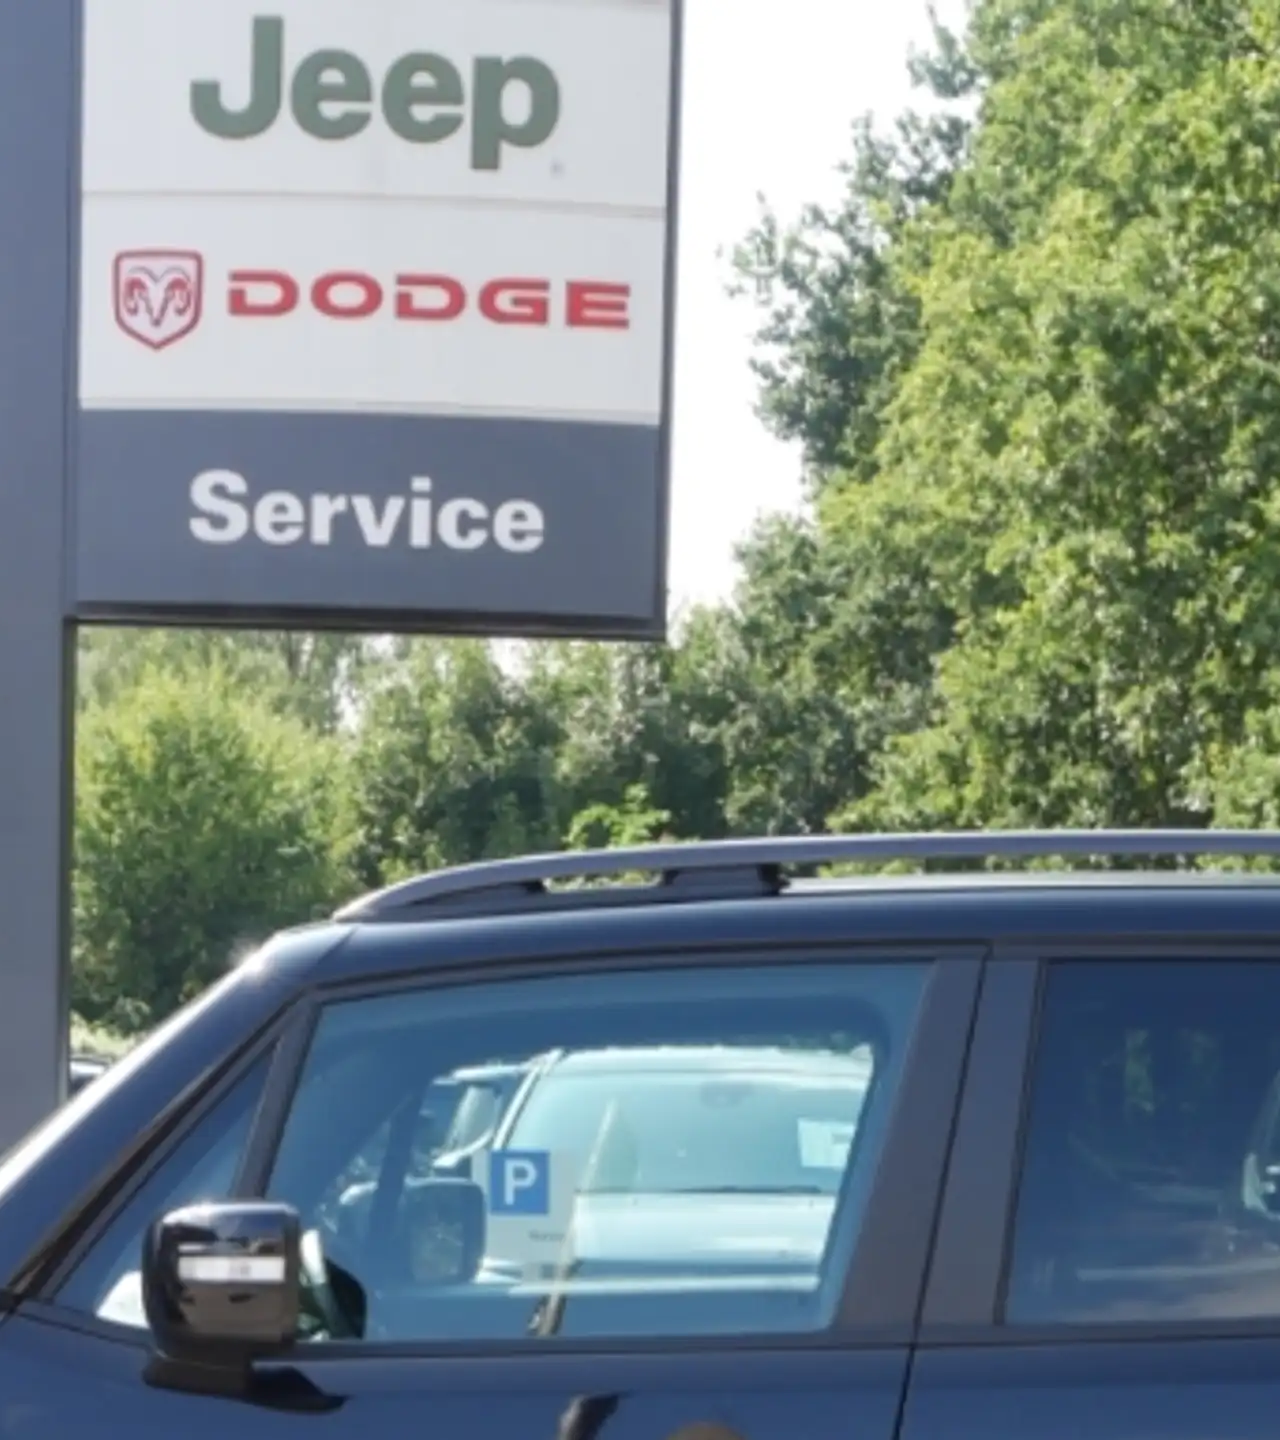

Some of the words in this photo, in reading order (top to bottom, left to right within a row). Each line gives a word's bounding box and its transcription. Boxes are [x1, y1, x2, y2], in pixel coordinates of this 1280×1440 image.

[190, 15, 561, 171] Jeep
[228, 269, 631, 330] DODGE
[189, 469, 544, 553] Service
[503, 1158, 538, 1206] P
